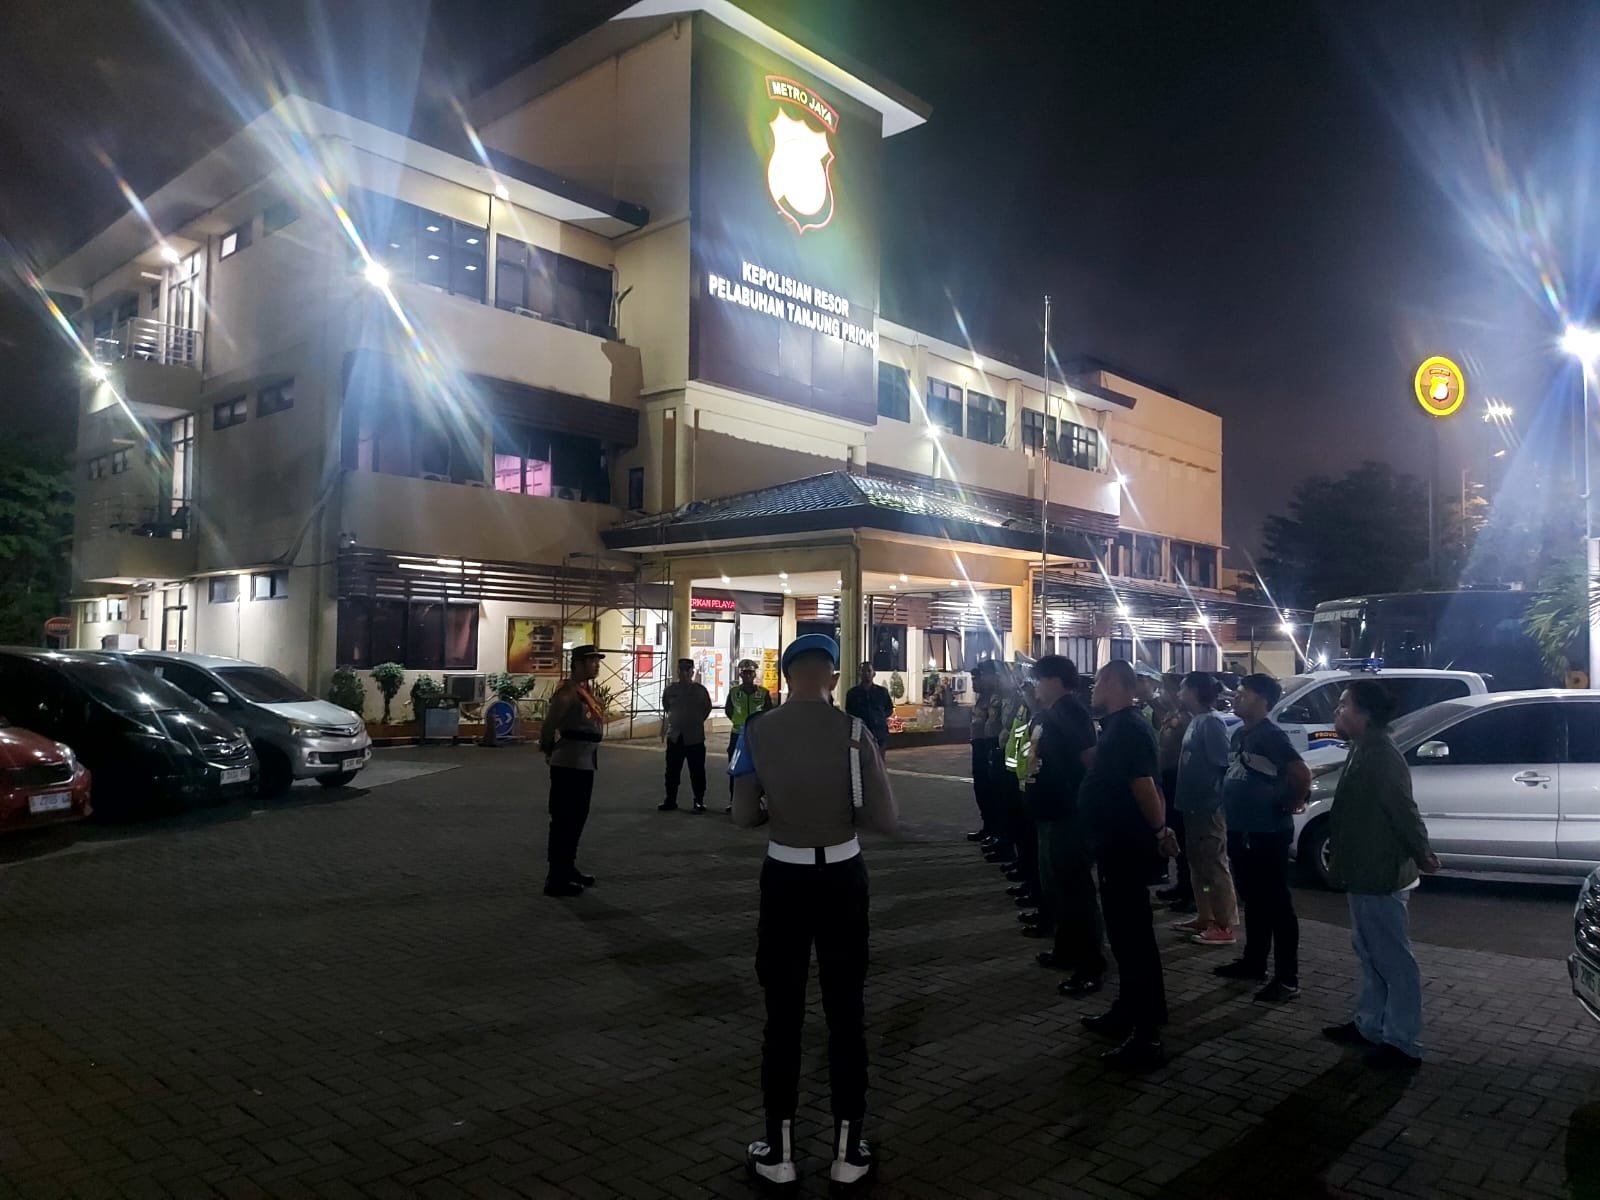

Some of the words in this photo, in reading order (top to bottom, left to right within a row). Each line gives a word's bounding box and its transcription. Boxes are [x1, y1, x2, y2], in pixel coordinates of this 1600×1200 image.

[772, 81, 807, 105] METRO
[809, 98, 831, 125] JAYA
[708, 274, 785, 319] PELABUHAN
[787, 302, 840, 337] TANJUNG
[842, 322, 877, 349] PRIOK
[742, 261, 812, 304] KEPOLISIAN
[814, 287, 849, 317] RESOR
